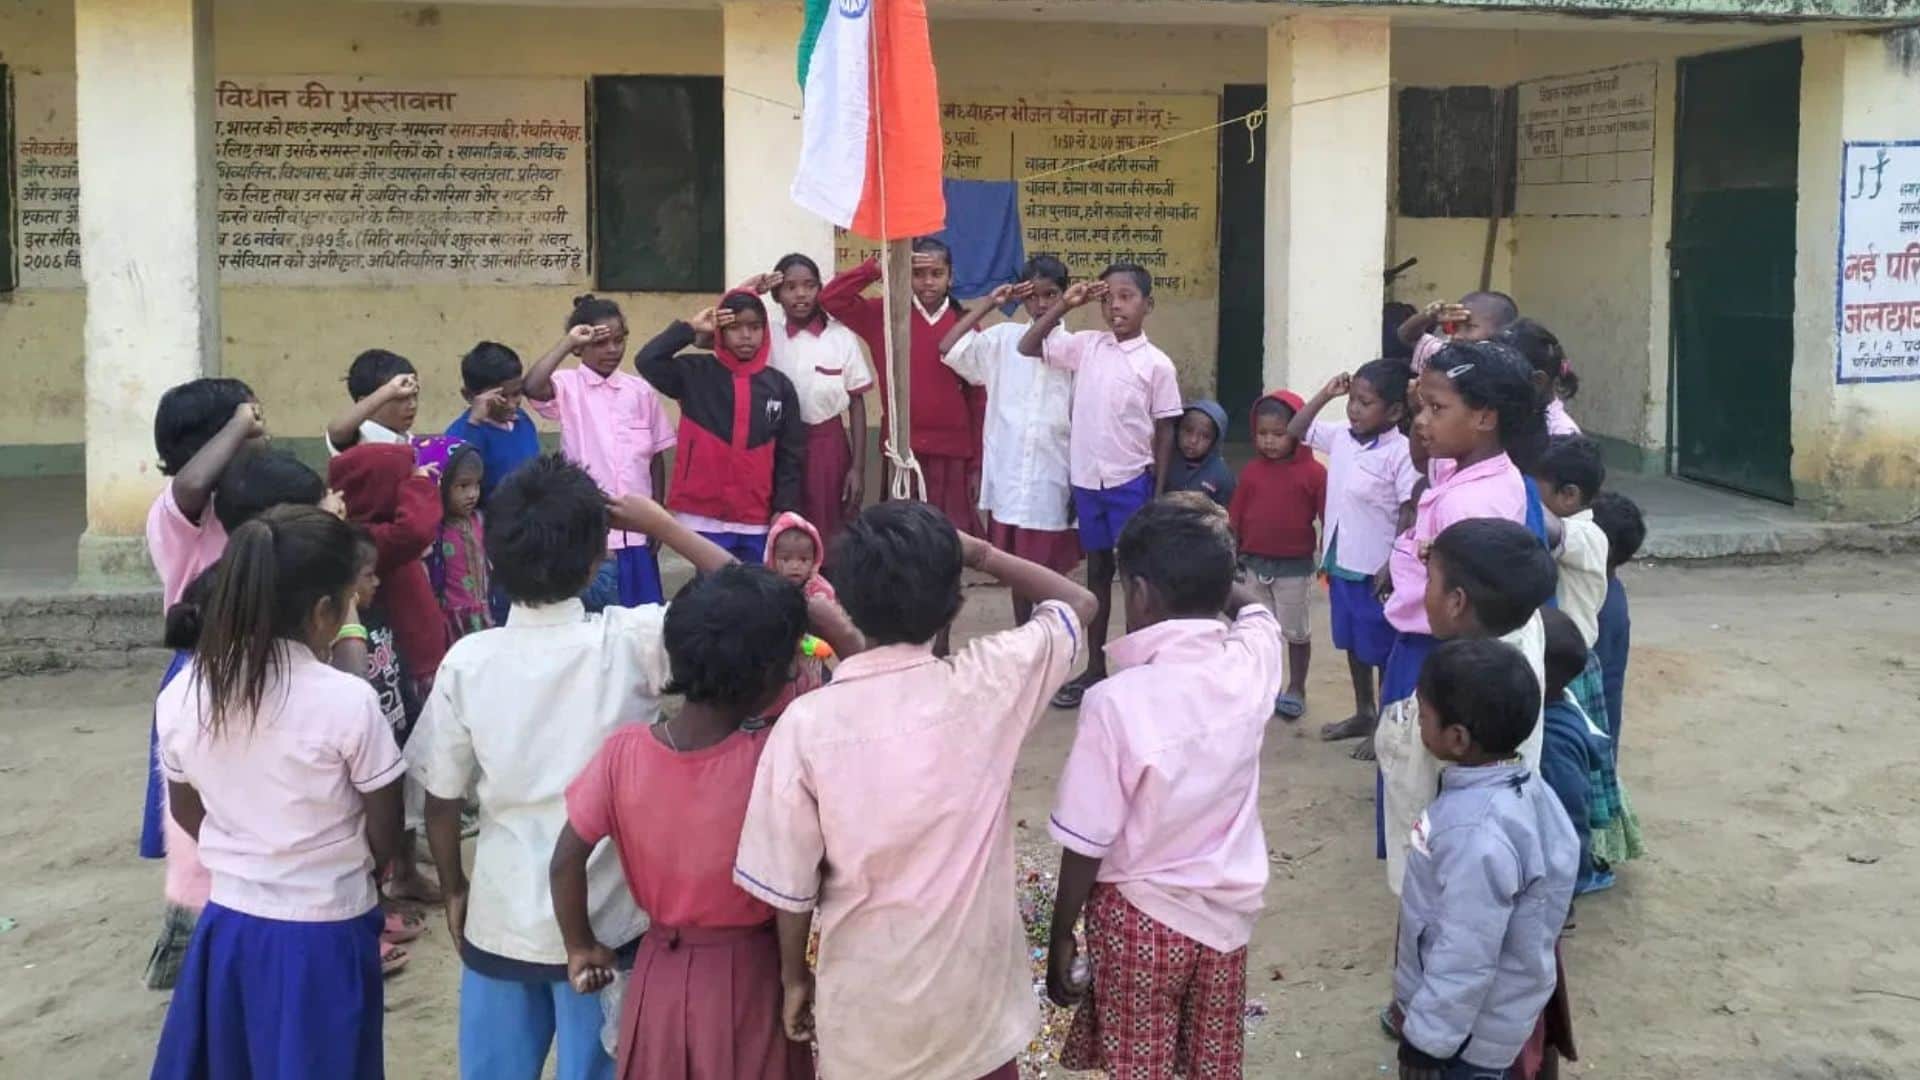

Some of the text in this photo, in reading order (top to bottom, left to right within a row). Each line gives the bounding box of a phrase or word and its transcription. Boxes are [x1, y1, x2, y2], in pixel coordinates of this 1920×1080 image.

[216, 81, 456, 113] विधान की प्रस्तावना
[1012, 98, 1051, 123] भोजन
[1056, 100, 1108, 124] योजना
[263, 116, 283, 136] को
[21, 137, 78, 156] लोकतंत्रा
[253, 144, 281, 158] तथा
[422, 140, 443, 159] को
[358, 162, 387, 181] और
[436, 163, 456, 181] की
[223, 183, 240, 201] के
[272, 189, 300, 201] तथा
[302, 189, 322, 201] उन
[409, 184, 431, 203] की
[432, 184, 471, 204] गरिमा
[474, 184, 500, 203] और
[530, 184, 554, 202] की
[252, 205, 288, 224] वाली
[24, 231, 49, 252] इस
[232, 231, 250, 247] 26
[229, 249, 281, 270] संविधान
[284, 249, 306, 270] को
[450, 250, 479, 270] और
[1845, 243, 1880, 291] नई
